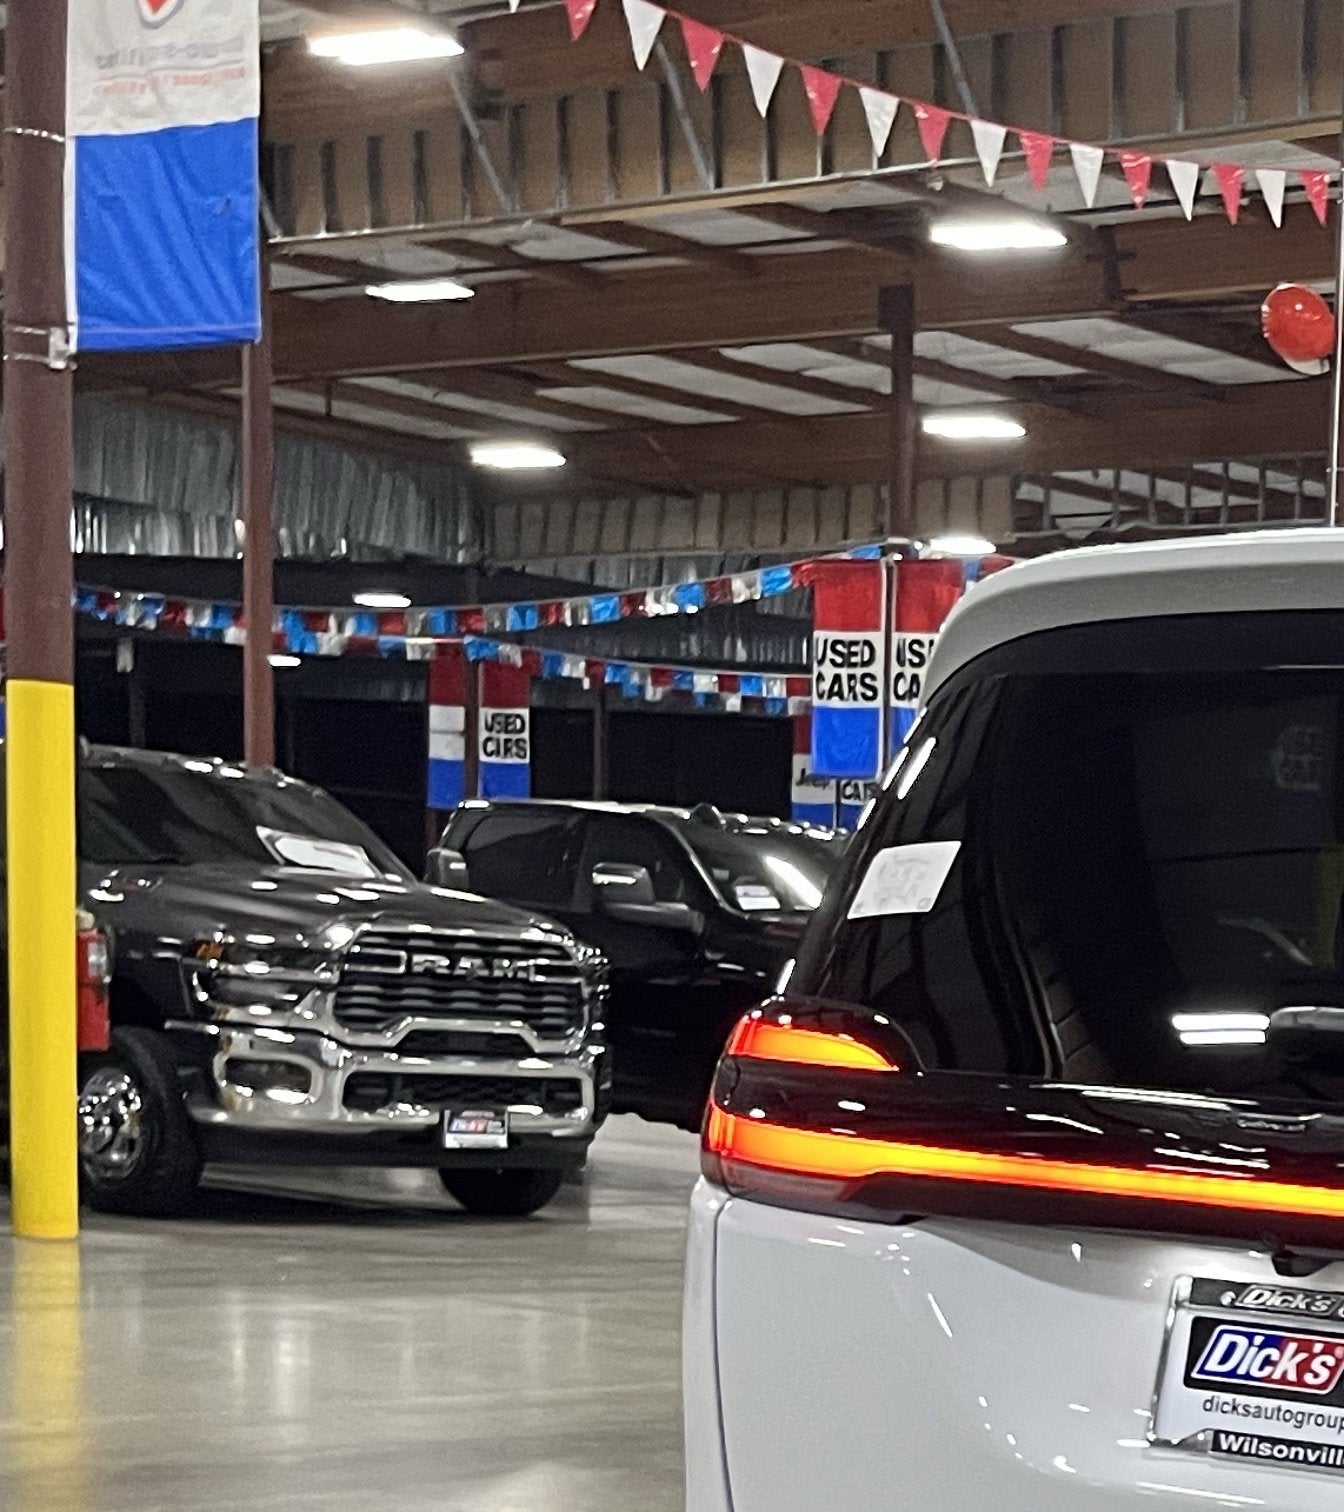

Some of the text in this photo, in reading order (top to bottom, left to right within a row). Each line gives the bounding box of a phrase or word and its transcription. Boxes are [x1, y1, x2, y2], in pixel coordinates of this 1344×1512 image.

[815, 638, 877, 669] USED
[896, 638, 935, 669] US
[815, 672, 879, 702] CARS
[893, 673, 921, 703] CA
[411, 954, 529, 978] RAM
[1243, 1288, 1334, 1313] Dick's
[1203, 1331, 1337, 1386] Dick's
